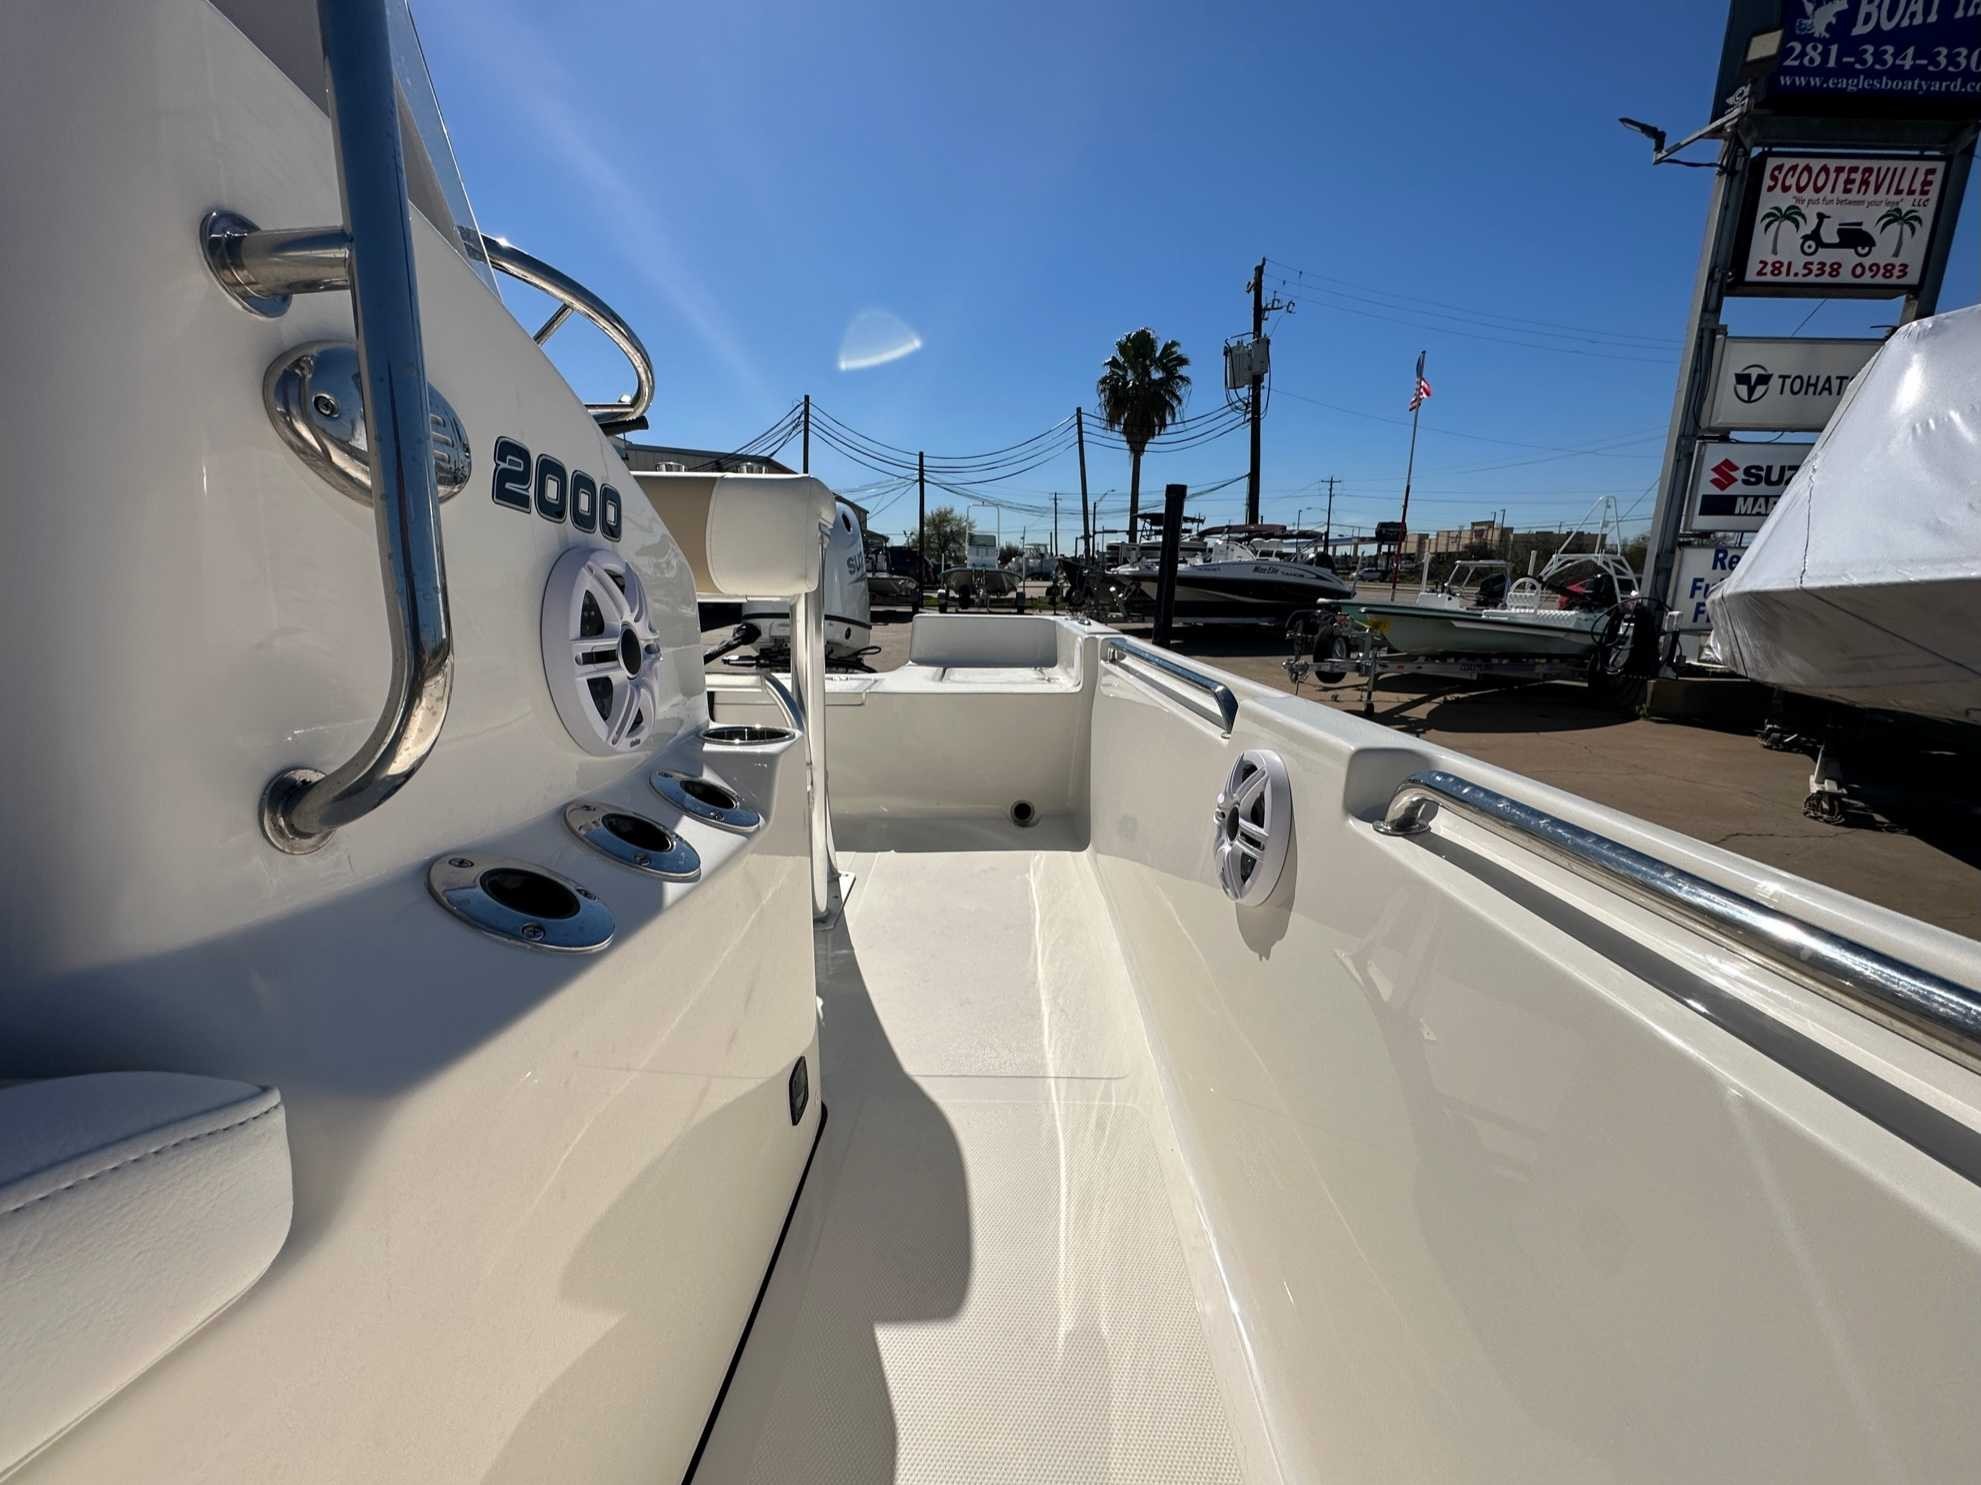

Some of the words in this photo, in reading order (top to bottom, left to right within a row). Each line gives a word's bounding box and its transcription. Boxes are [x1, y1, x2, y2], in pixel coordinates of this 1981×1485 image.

[1766, 163, 1937, 196] SCOOTERVILLE
[1912, 199, 1930, 208] LLC
[1756, 260, 1842, 278] 281.538
[1851, 262, 1909, 279] 0983
[1778, 374, 1855, 396] TOHAT
[492, 436, 622, 543] 2000
